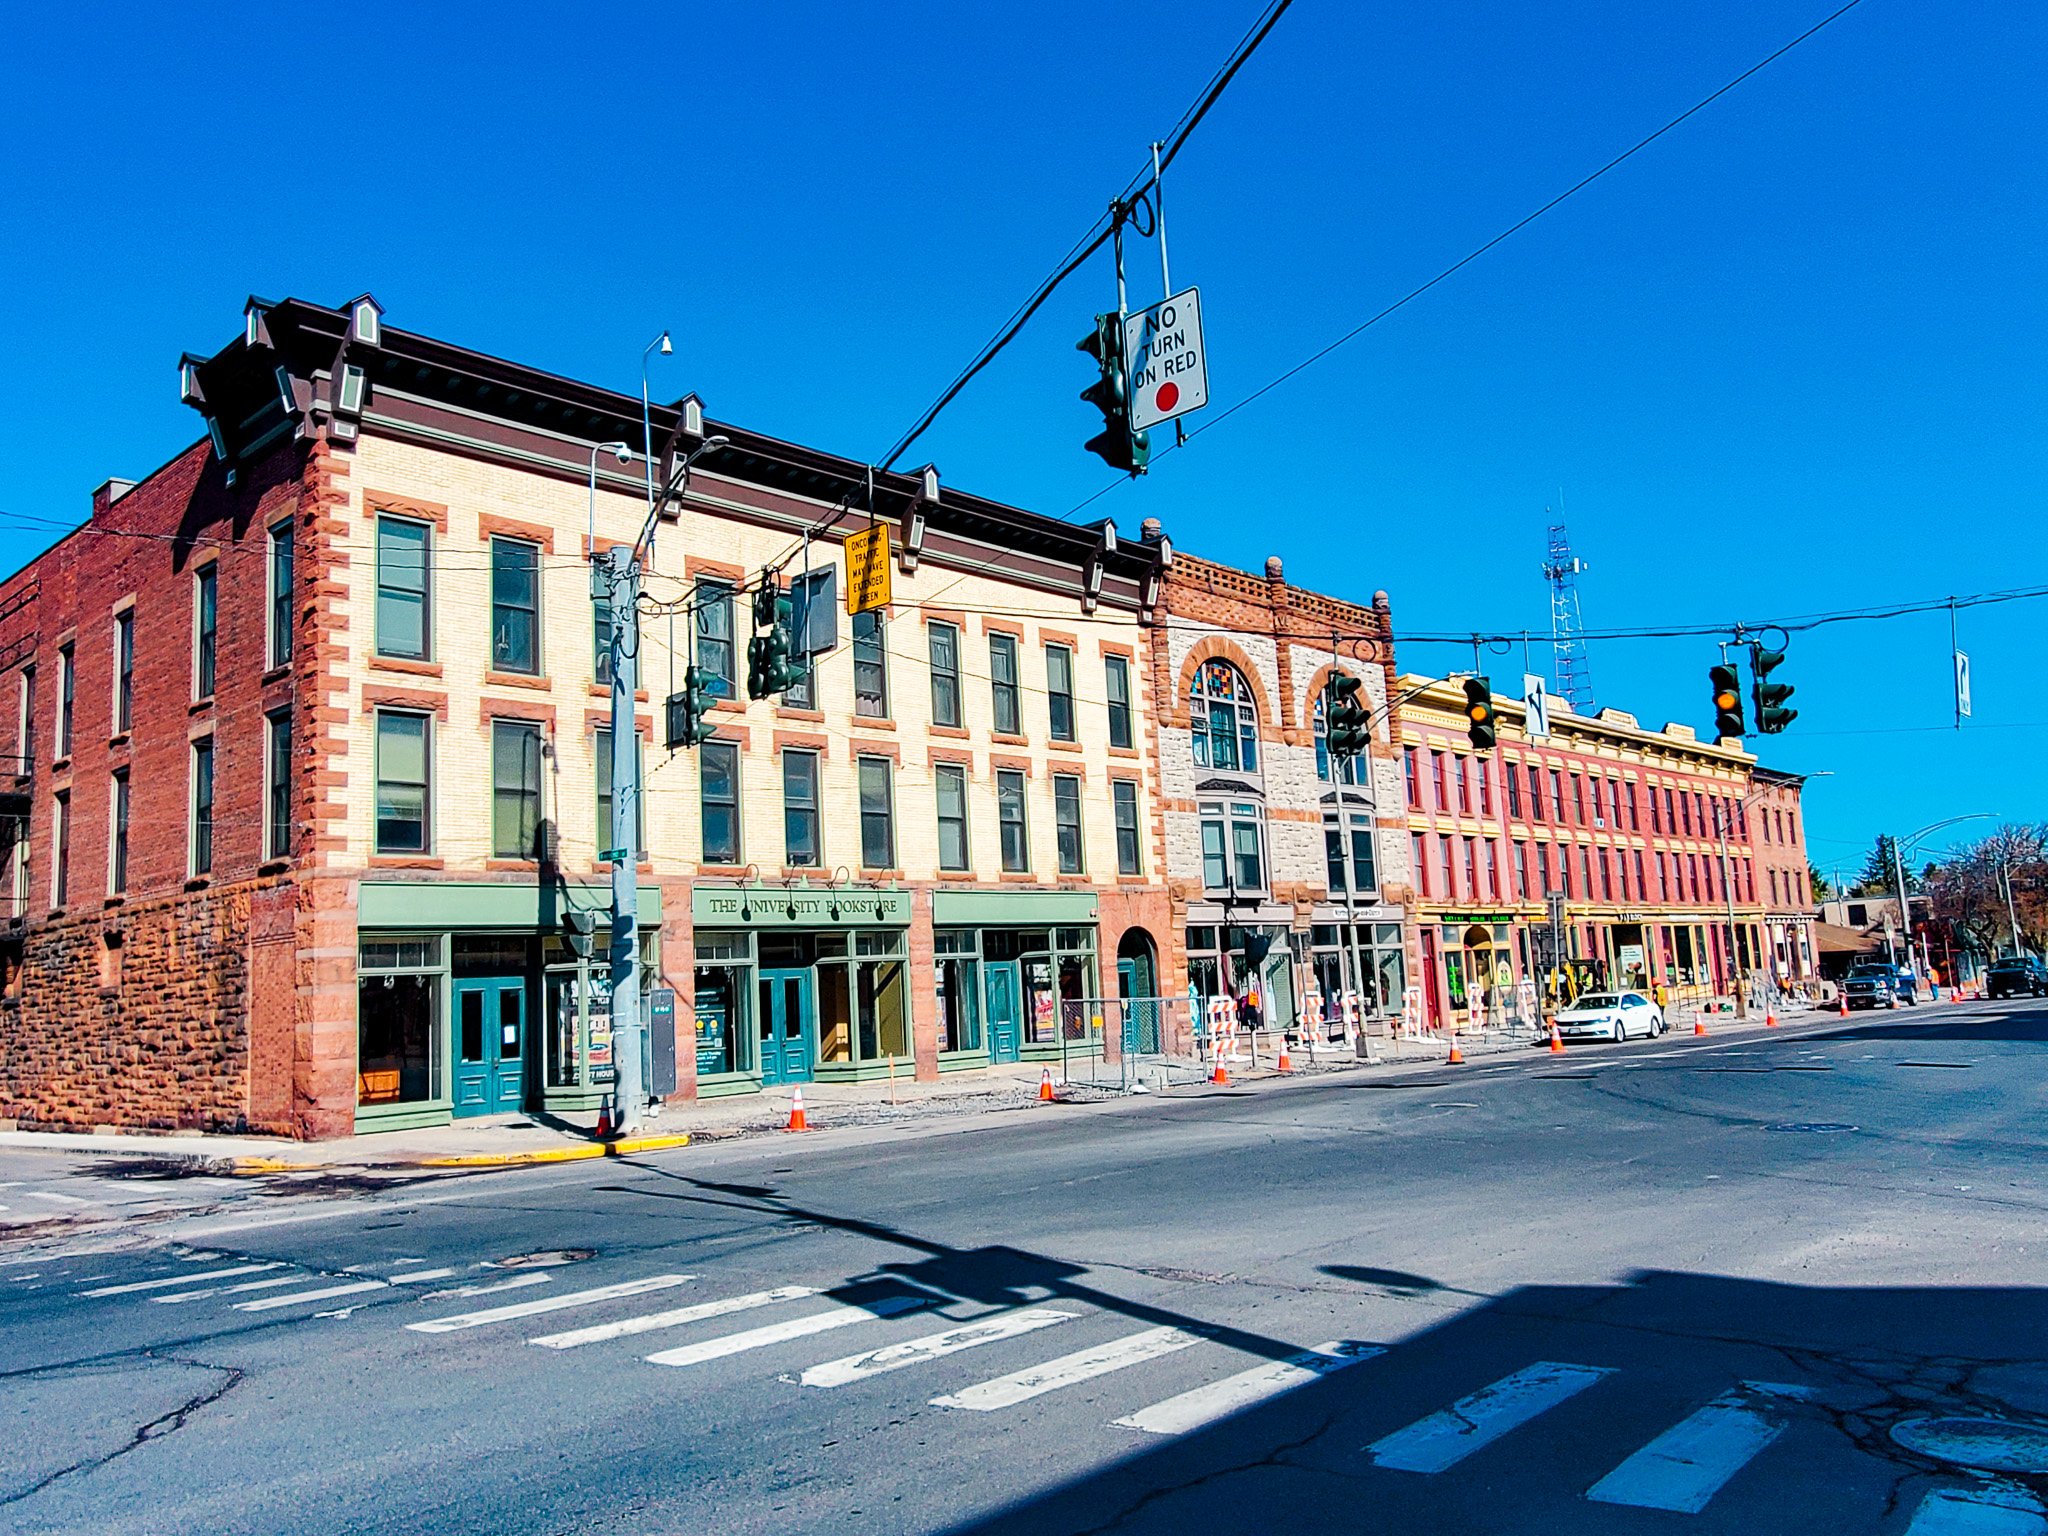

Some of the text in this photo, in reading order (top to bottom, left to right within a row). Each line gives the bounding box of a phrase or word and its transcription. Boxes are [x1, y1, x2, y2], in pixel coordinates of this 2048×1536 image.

[1145, 306, 1176, 337] NO
[1142, 329, 1185, 361] TURN
[1135, 350, 1197, 389] ON RED
[855, 548, 880, 564] TRAFFIC
[853, 567, 865, 579] MAY
[854, 575, 883, 593] EXTENDED
[860, 592, 878, 605] GREEN
[709, 899, 737, 913] THE
[826, 899, 897, 913] BOOKSTORE
